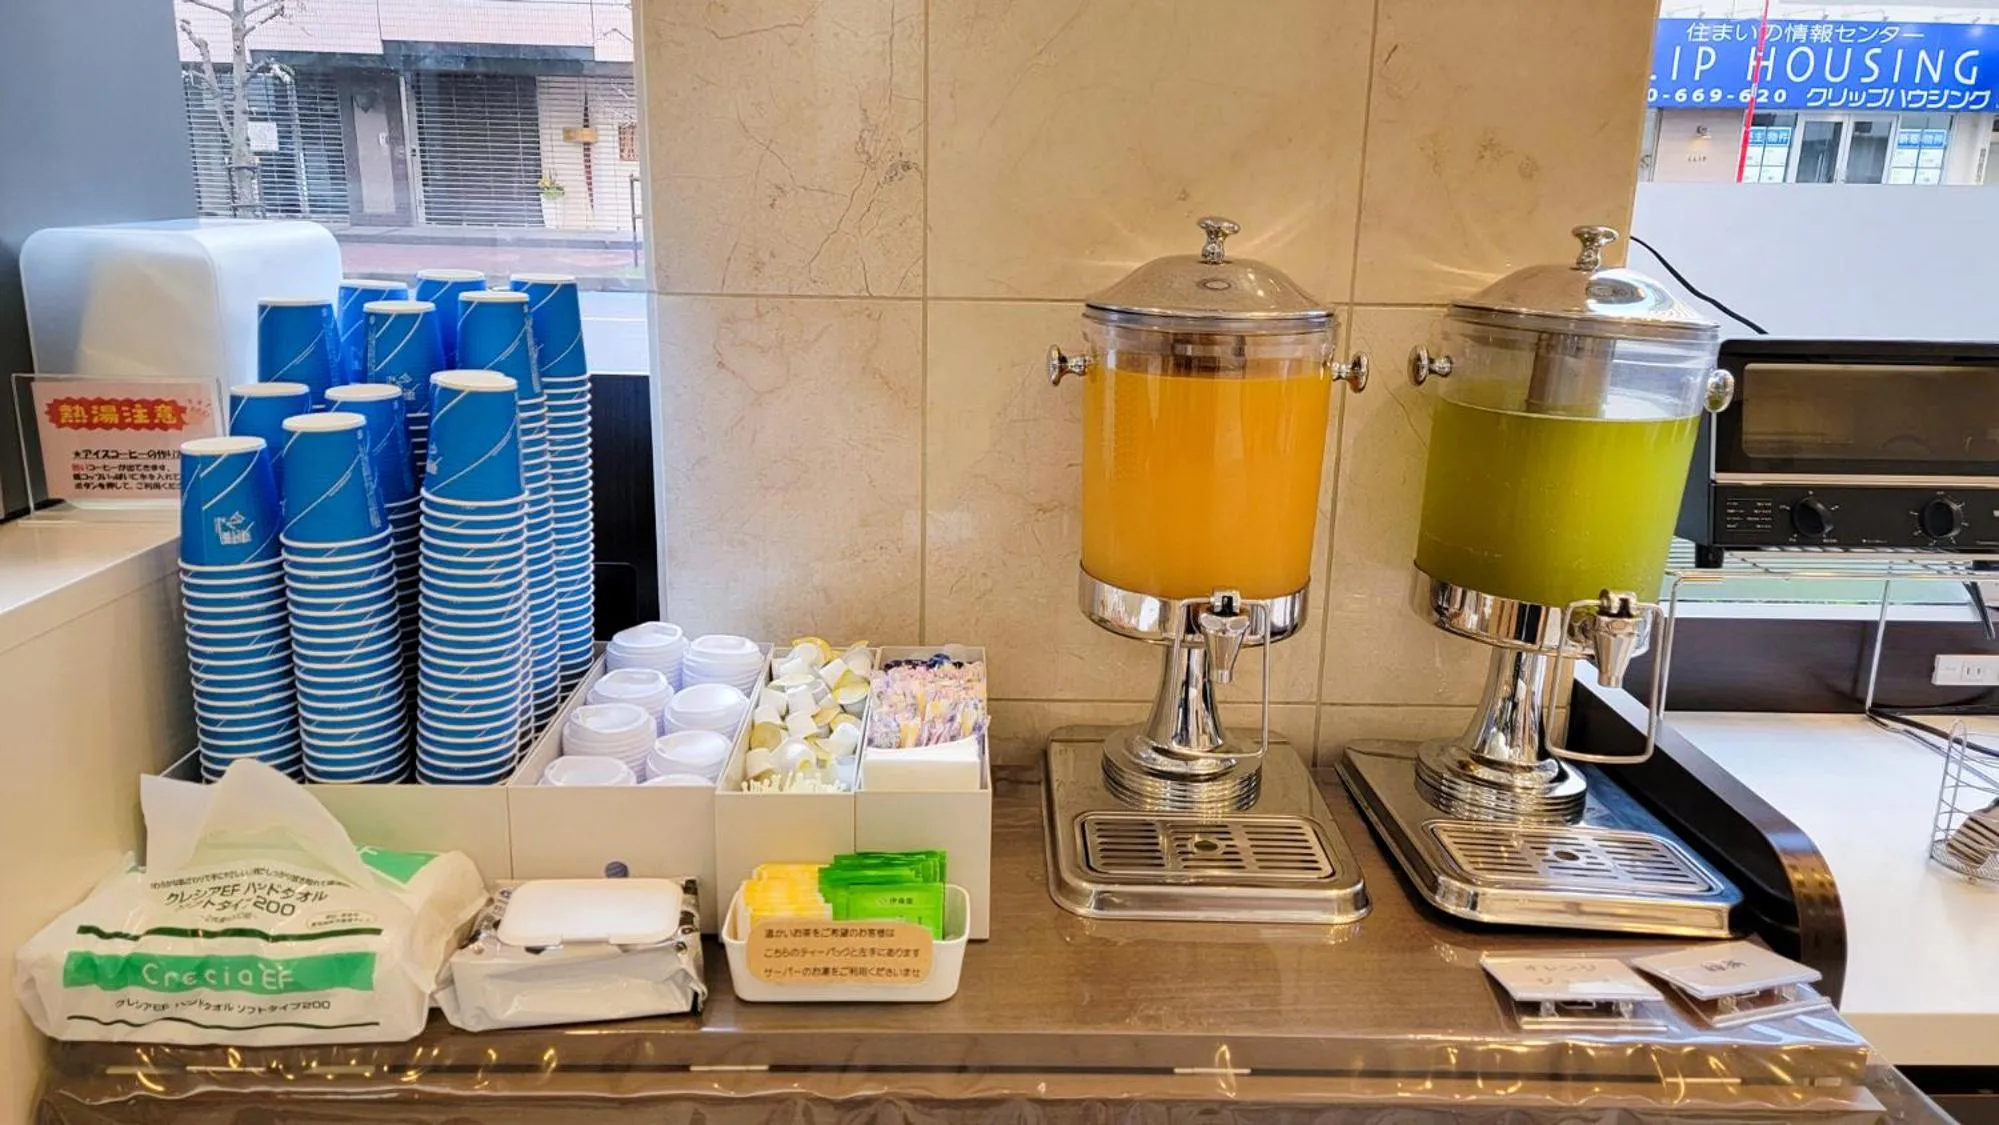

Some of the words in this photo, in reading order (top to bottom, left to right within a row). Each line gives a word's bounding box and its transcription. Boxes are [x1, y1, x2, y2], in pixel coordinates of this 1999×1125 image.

[1687, 22, 1925, 44] 住まいの情報センター
[1649, 45, 1717, 81] IP
[1746, 46, 1980, 85] HOUSING
[1806, 87, 1991, 110] クリップハウジング
[58, 403, 179, 425] 熱湯注意
[164, 883, 241, 906] クレシアEF
[243, 881, 330, 903] ハンドタオル
[142, 963, 253, 986] Crecia
[237, 1000, 331, 1014] ソフトタイプ200
